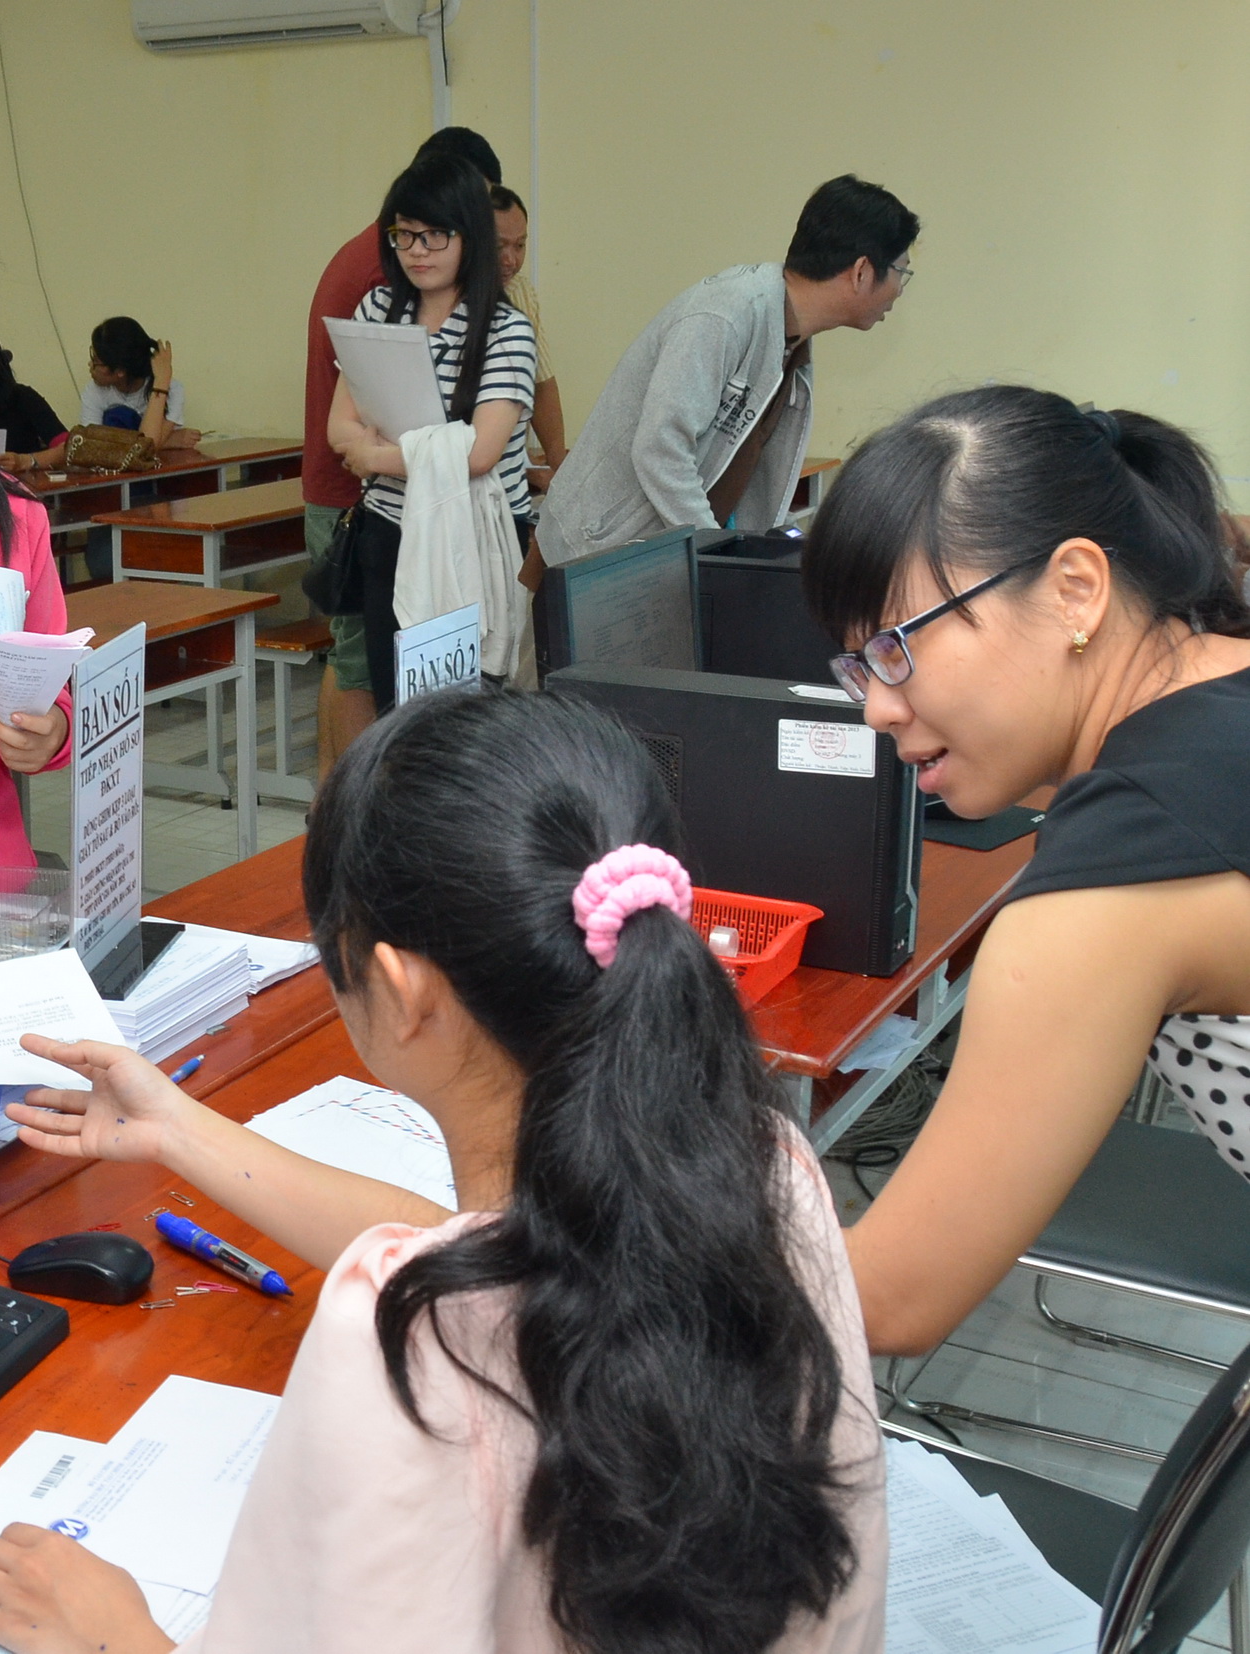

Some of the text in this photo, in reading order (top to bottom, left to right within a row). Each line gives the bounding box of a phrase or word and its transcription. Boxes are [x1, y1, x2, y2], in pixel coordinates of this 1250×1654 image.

[406, 638, 476, 699] BÀN SỐ 2
[81, 667, 140, 748] BÀN SỐ 1
[80, 728, 141, 788] TIẾP NHẬN HỒ SƠ
[100, 768, 121, 797] ĐKXT
